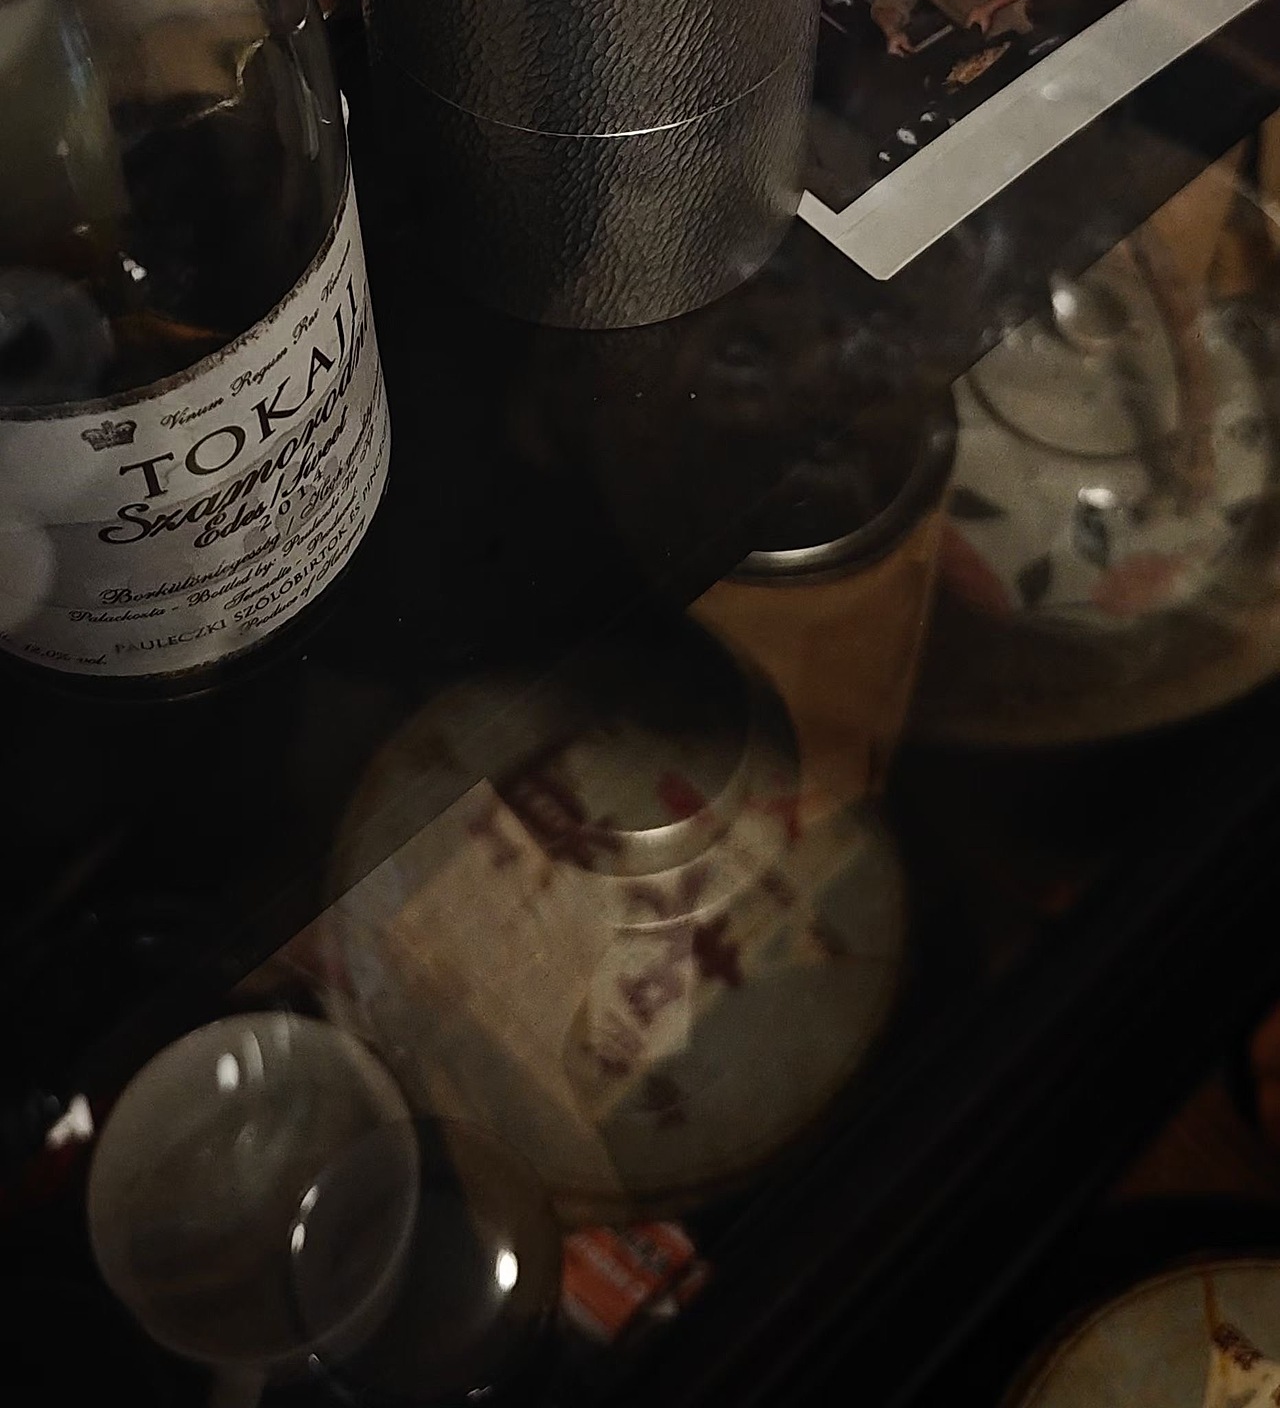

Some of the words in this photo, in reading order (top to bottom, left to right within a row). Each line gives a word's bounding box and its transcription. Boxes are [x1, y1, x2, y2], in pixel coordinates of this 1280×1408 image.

[119, 273, 358, 499] TOKAJI
[161, 397, 224, 430] Vinum
[232, 347, 288, 397] Regum
[259, 464, 322, 532] 2014
[68, 608, 166, 624] Palackozta
[186, 568, 254, 607] Bottled
[115, 619, 226, 653] PAULECZKI
